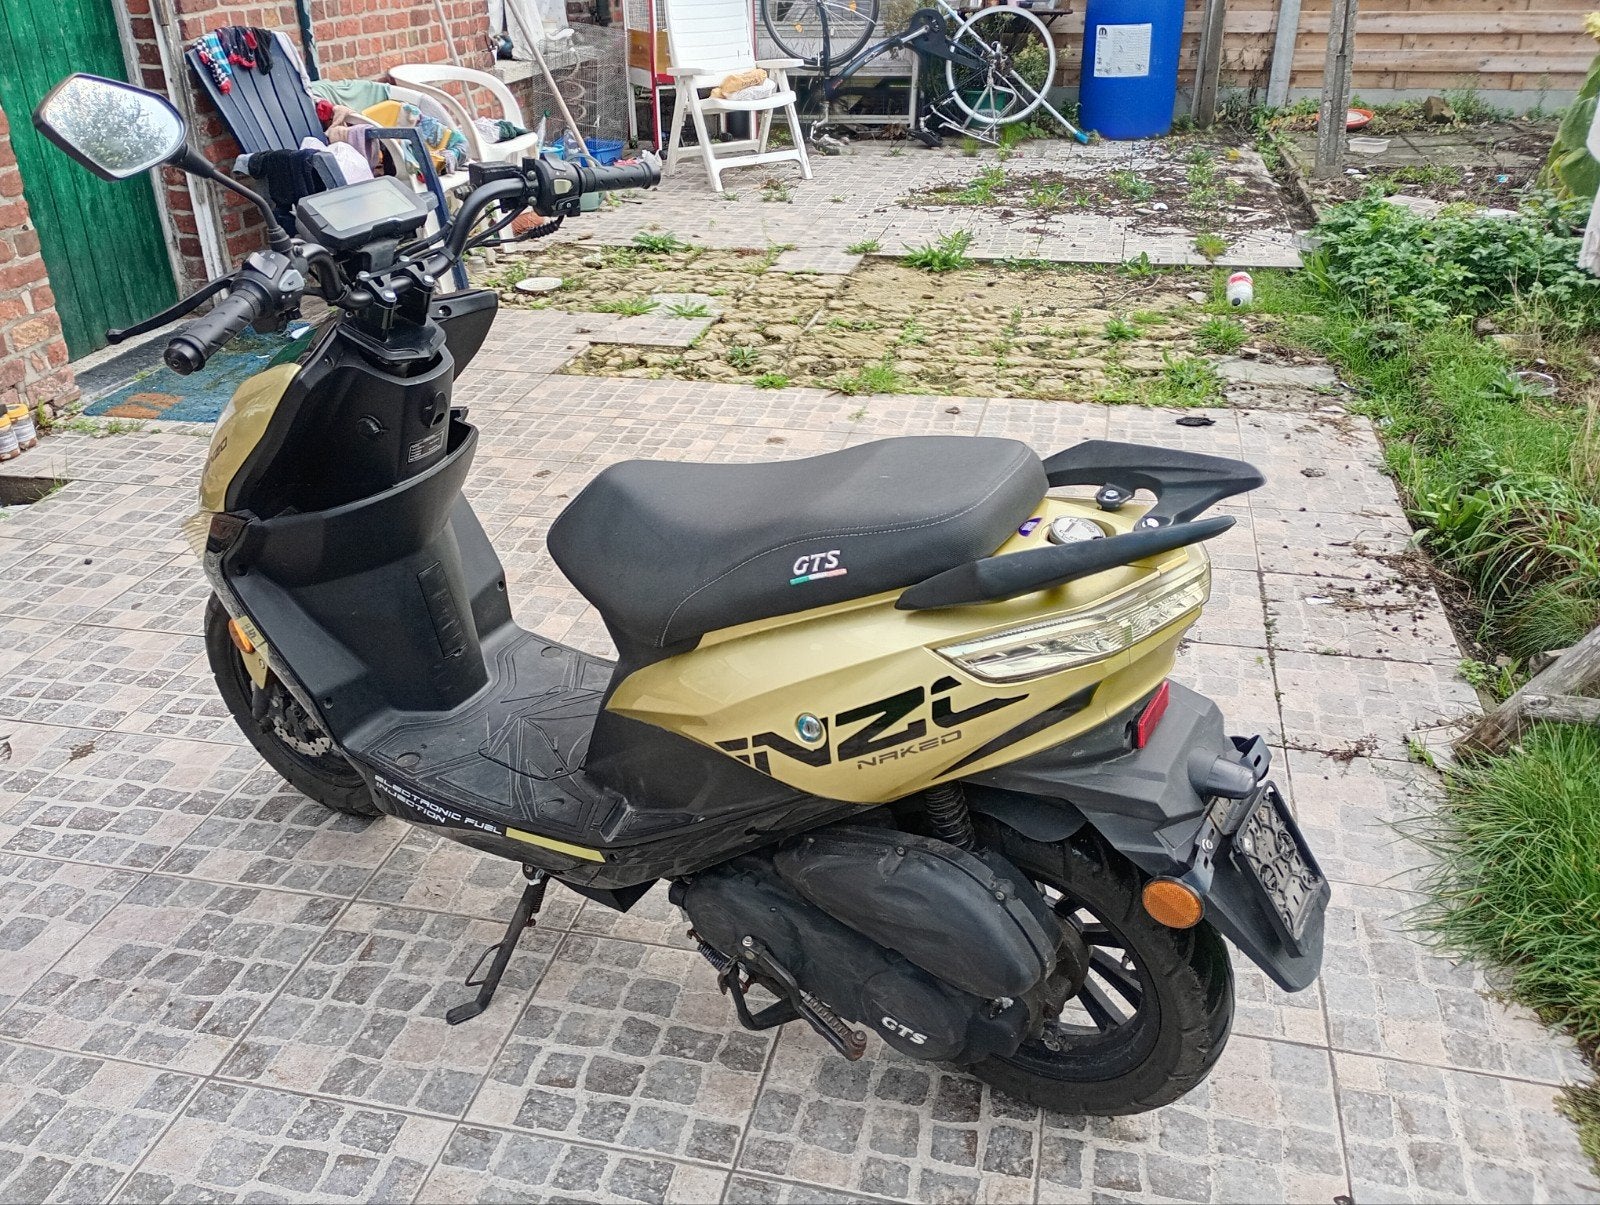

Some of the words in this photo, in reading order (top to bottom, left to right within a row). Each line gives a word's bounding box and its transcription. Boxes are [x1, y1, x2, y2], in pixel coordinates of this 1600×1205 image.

[793, 549, 840, 576] GTS
[857, 729, 962, 769] NAKED
[374, 774, 461, 821] ELECTRONIC
[464, 817, 502, 835] FUEL
[376, 781, 446, 824] INJECTION
[881, 1016, 928, 1045] GTS
